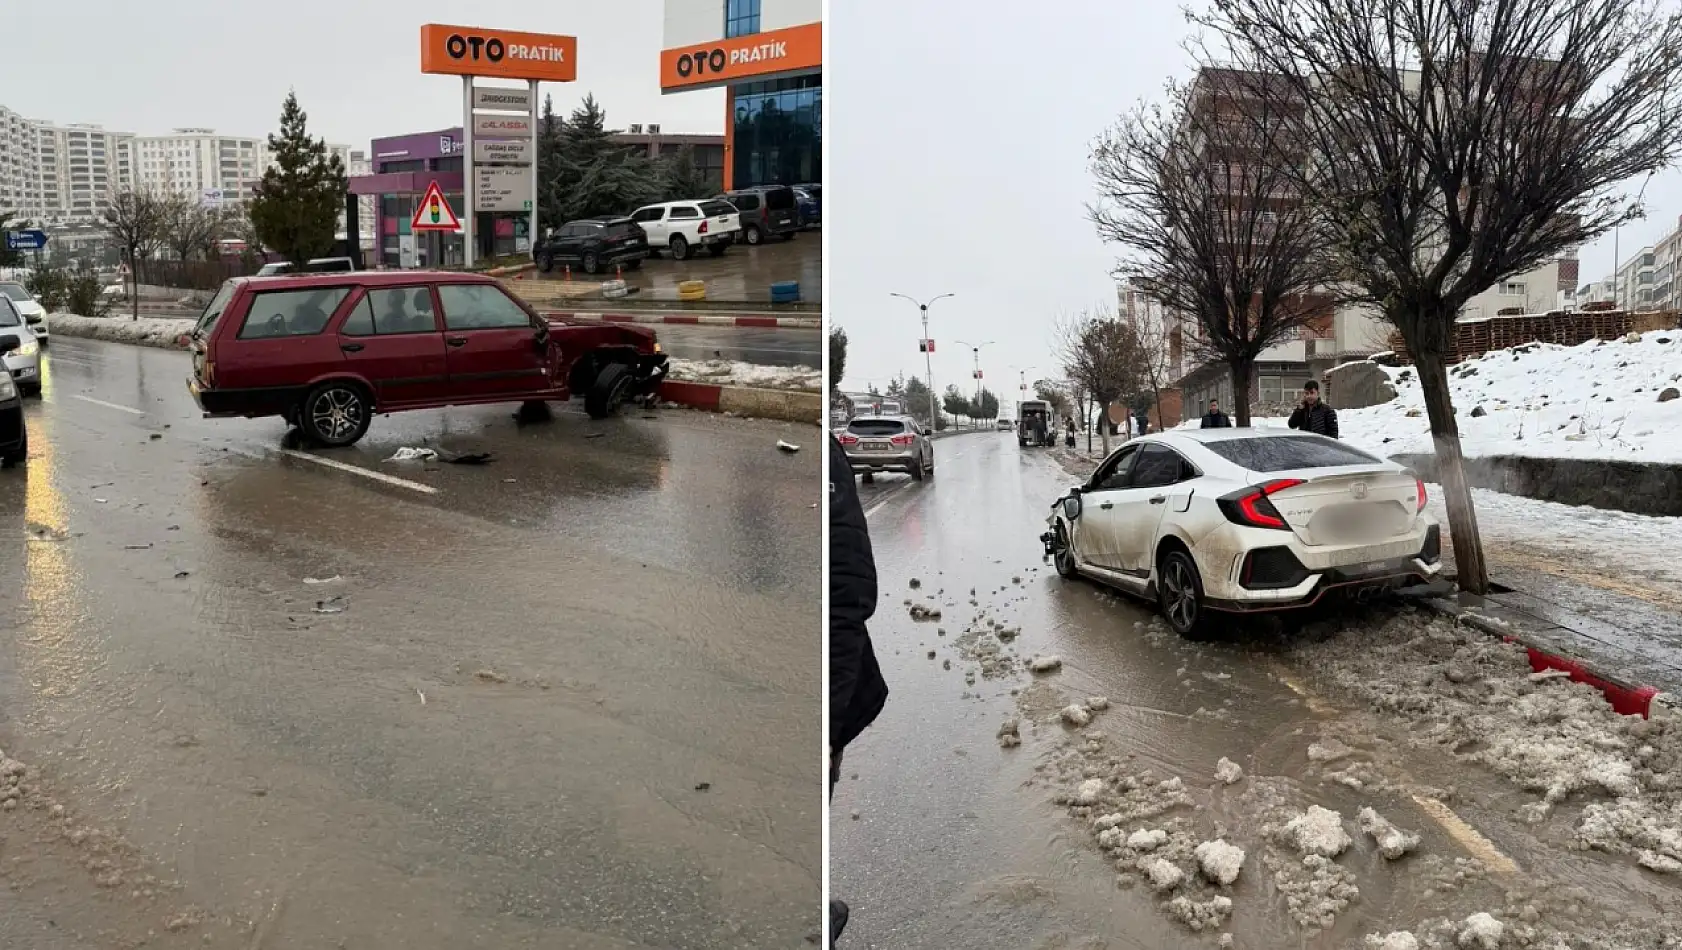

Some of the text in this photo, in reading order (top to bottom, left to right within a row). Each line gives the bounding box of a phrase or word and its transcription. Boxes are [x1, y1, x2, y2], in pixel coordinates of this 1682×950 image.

[446, 34, 564, 62] OTO PRATİK
[676, 39, 787, 77] OTO PRATİK
[481, 94, 528, 104] BRIDGESTONE
